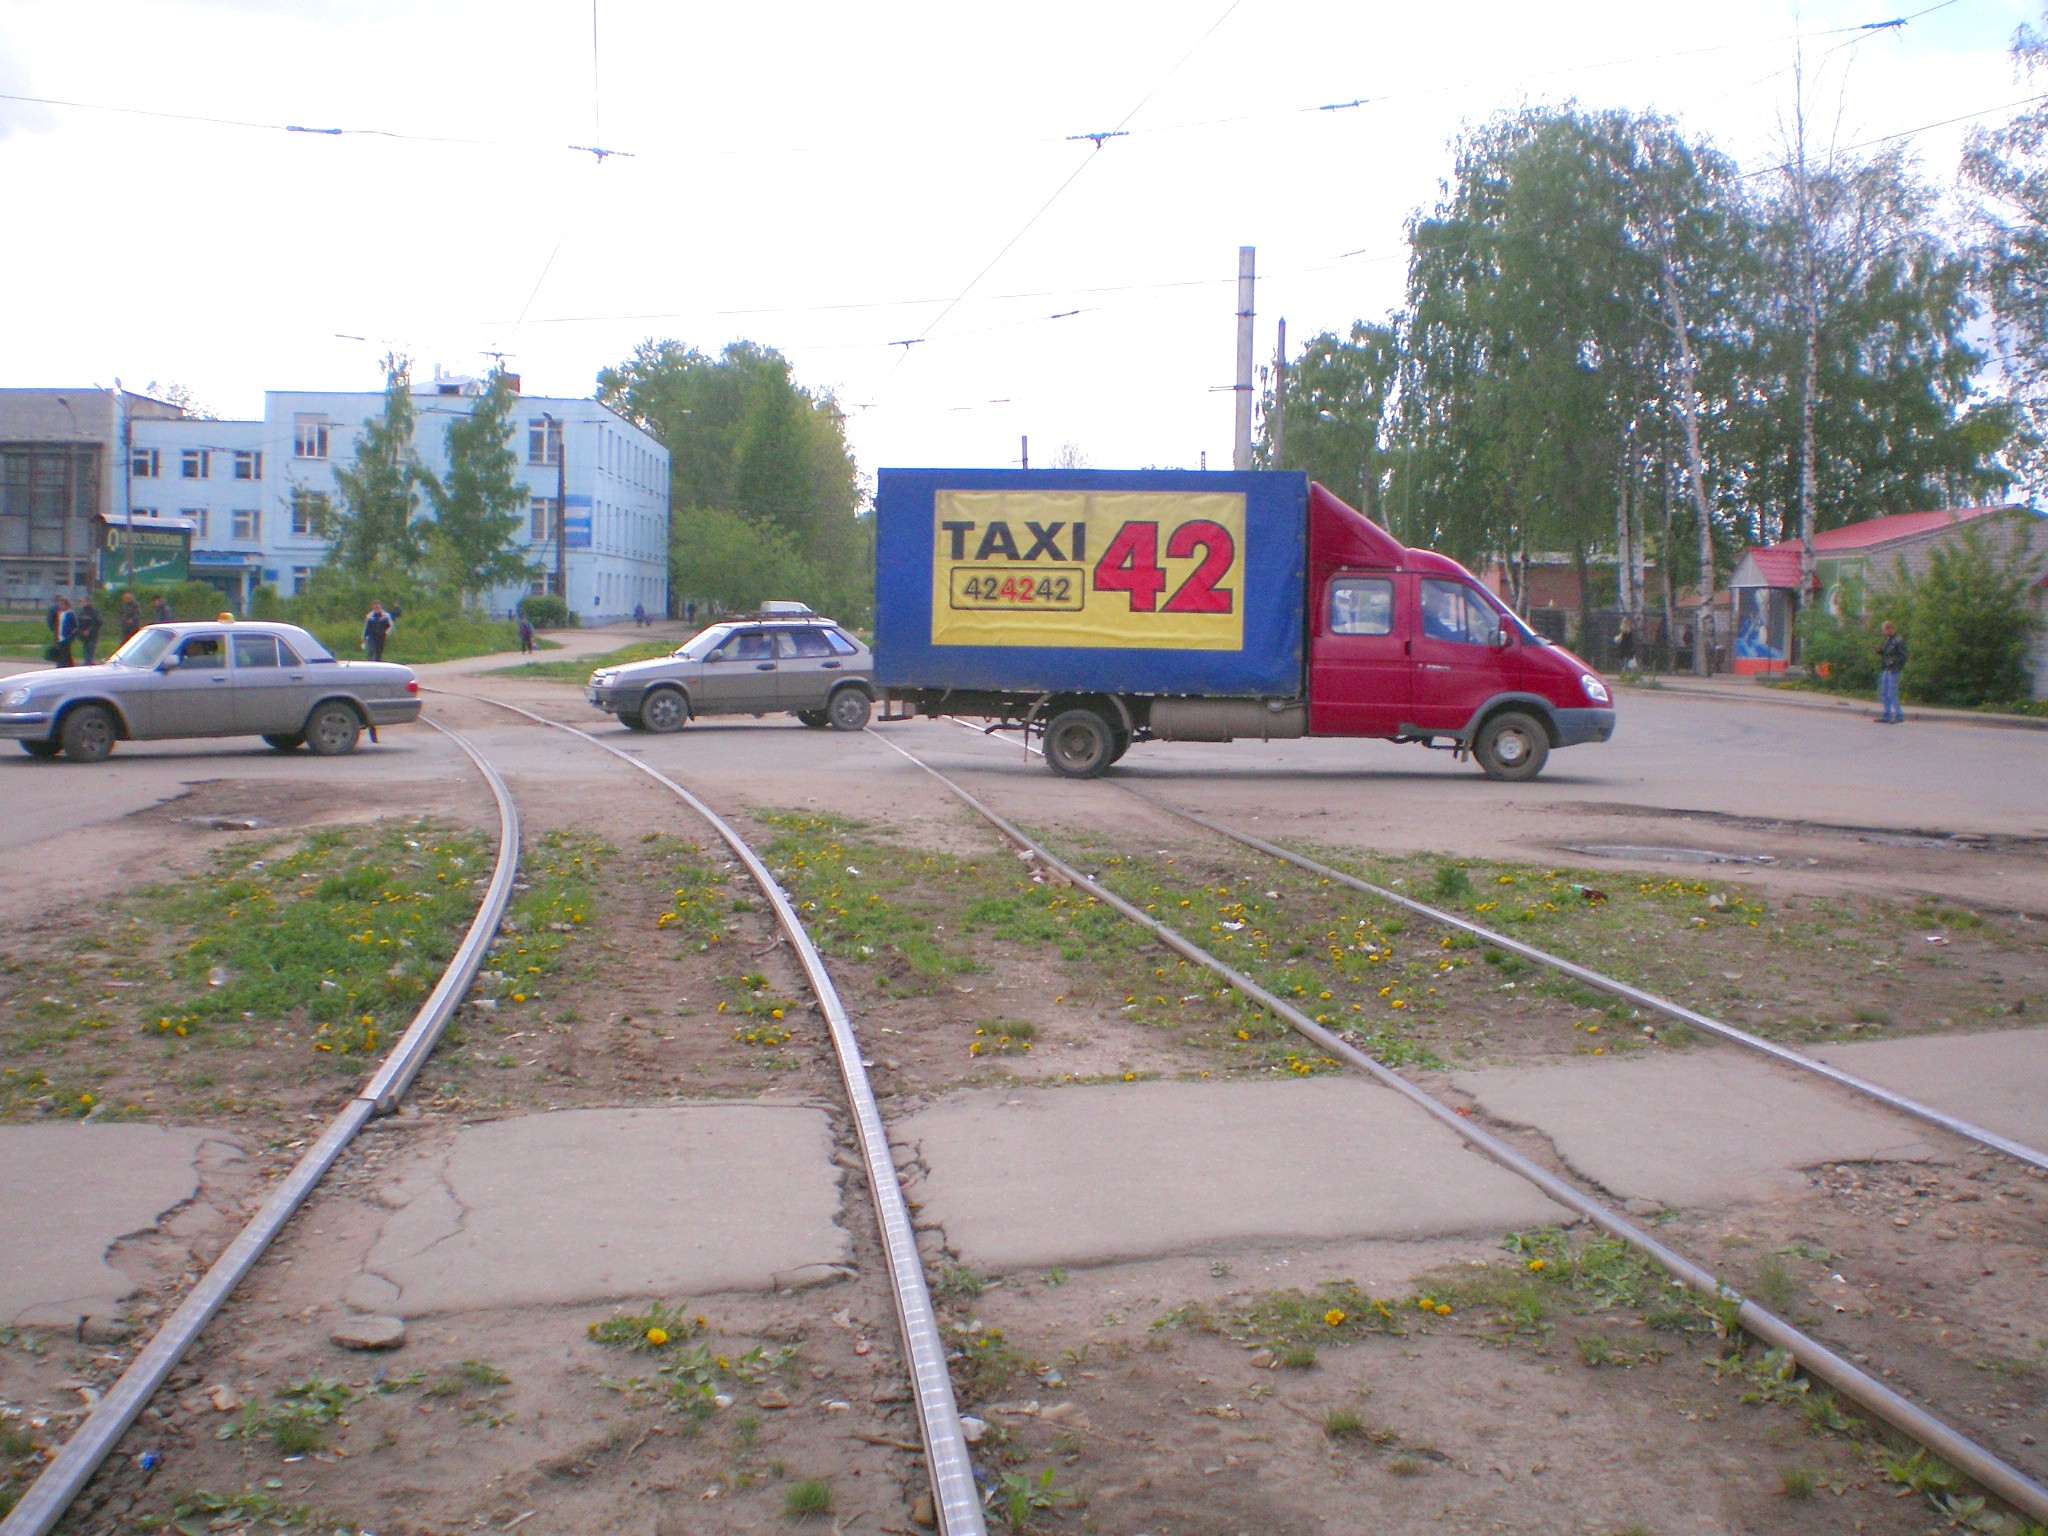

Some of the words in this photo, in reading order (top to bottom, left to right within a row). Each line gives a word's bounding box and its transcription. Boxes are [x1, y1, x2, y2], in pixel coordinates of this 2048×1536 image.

[942, 521, 1086, 561] TAXI
[1093, 519, 1235, 614] 42
[964, 576, 1071, 602] 424242
